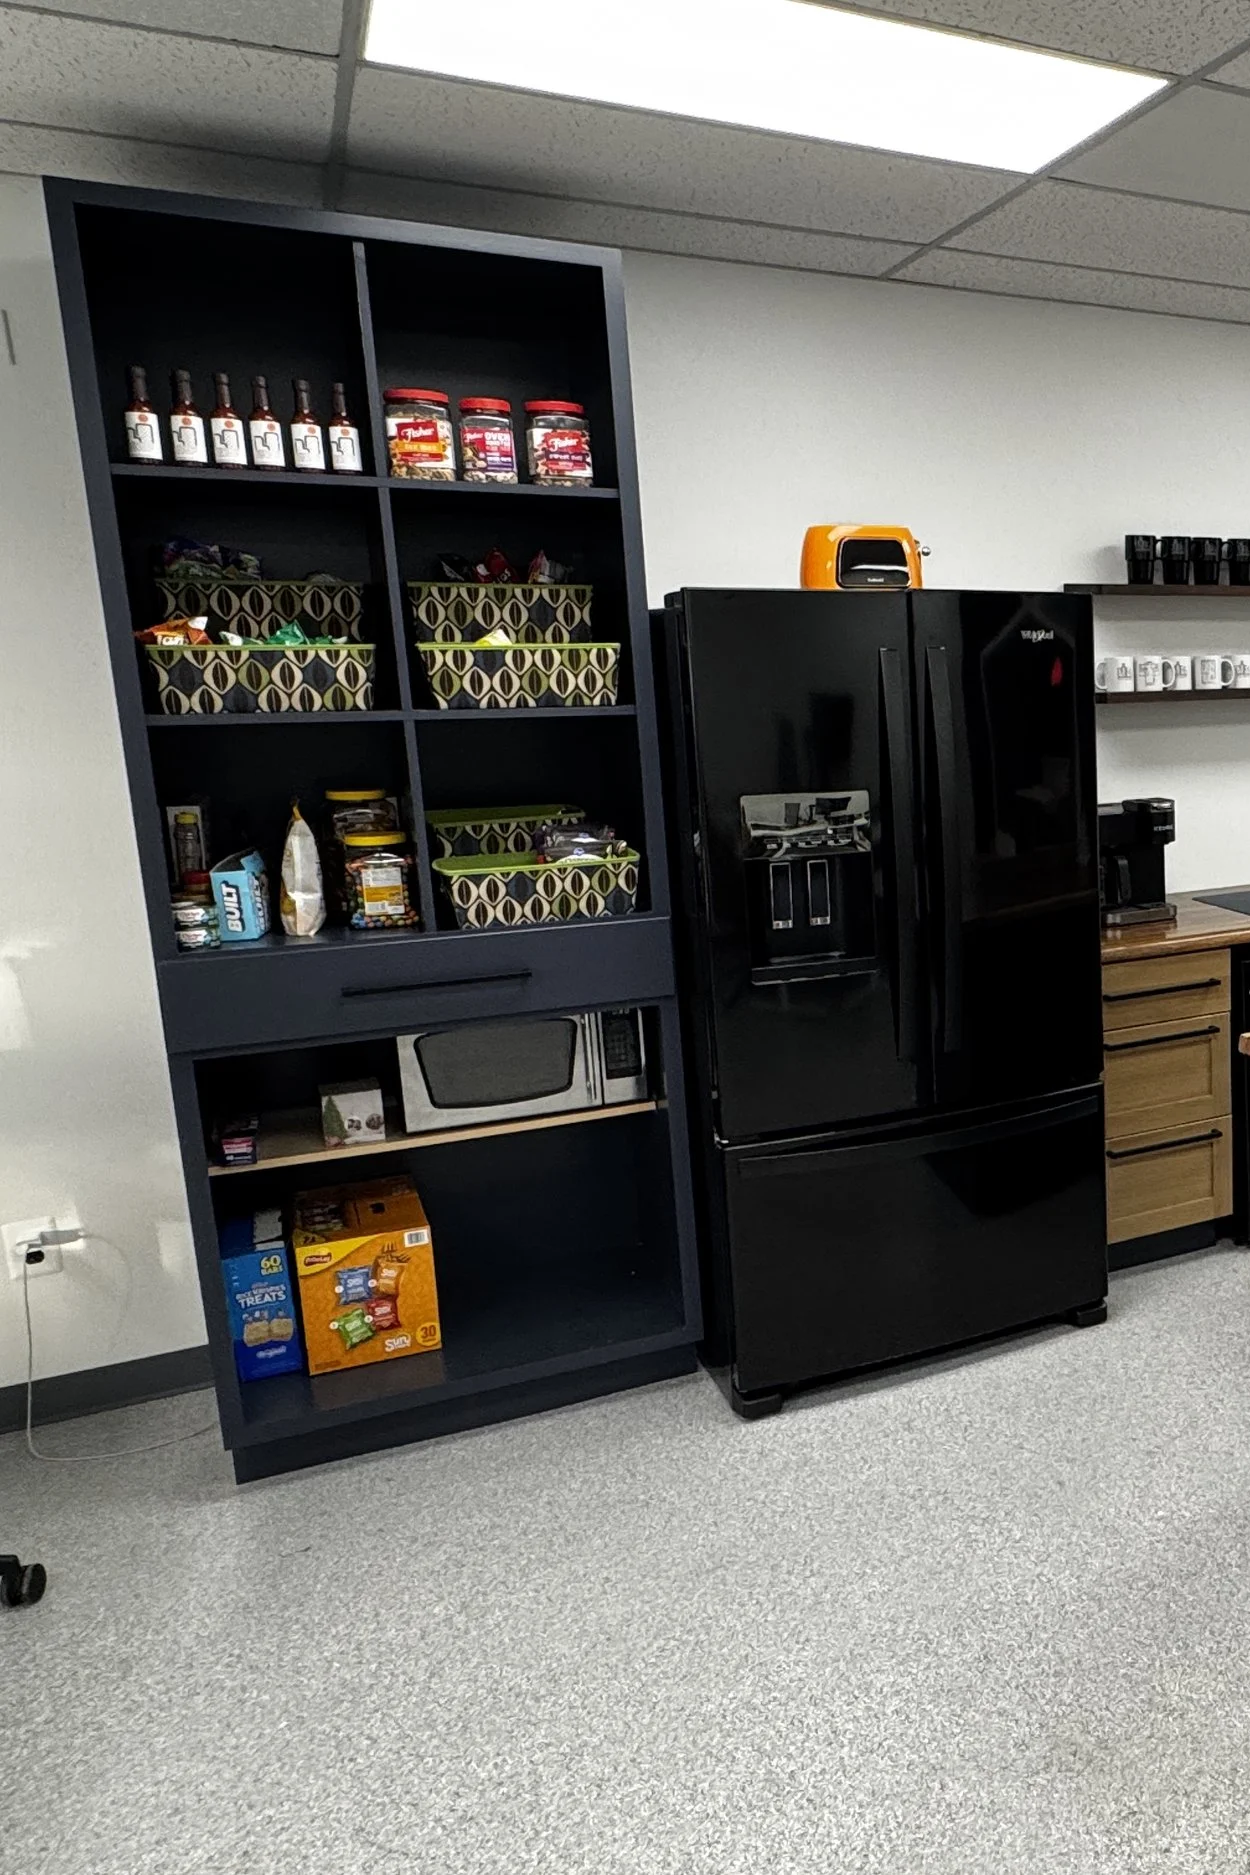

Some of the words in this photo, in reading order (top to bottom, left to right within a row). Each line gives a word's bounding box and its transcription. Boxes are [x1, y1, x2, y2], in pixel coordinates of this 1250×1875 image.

[400, 425, 435, 443] Fisher
[221, 882, 244, 932] BUILT
[260, 1254, 282, 1270] 60
[238, 1290, 287, 1309] TREATS
[420, 1325, 437, 1339] 30
